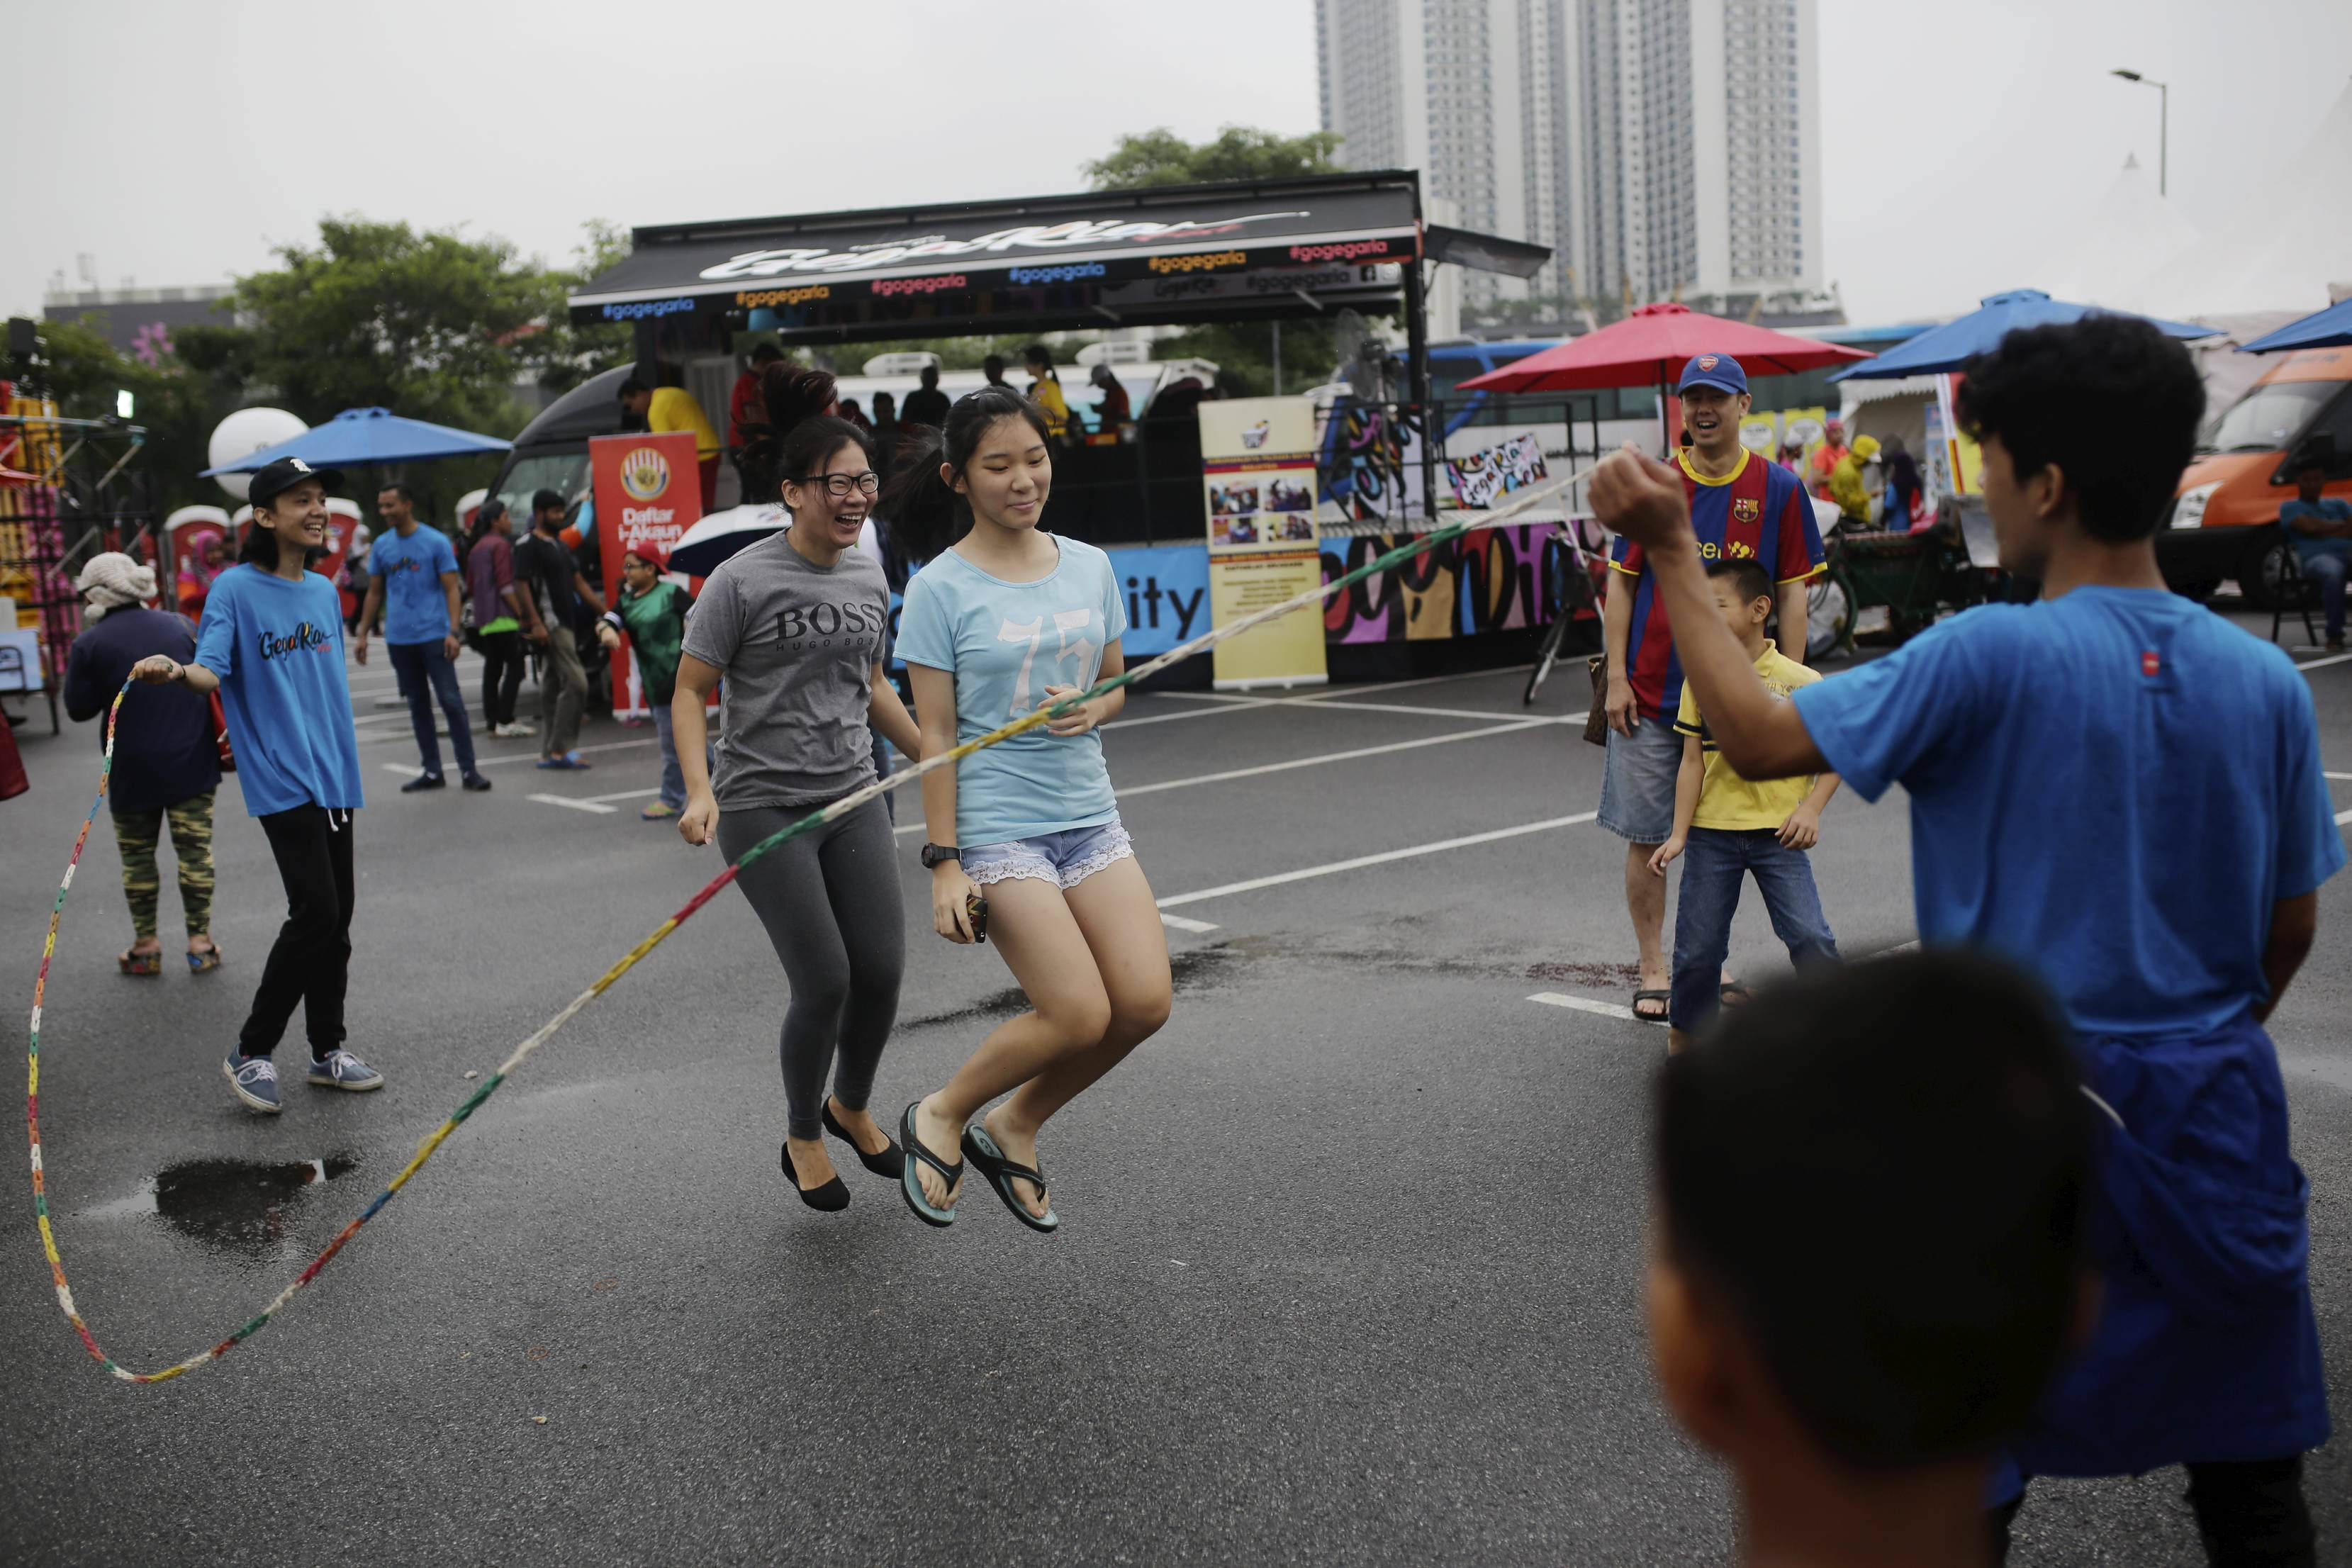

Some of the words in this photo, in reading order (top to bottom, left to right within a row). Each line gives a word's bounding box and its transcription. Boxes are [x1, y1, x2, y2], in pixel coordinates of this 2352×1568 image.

[1149, 250, 1246, 274] #gogegaria
[1289, 239, 1388, 262] #gogegaria
[872, 273, 966, 296] #gogegaria
[1009, 262, 1106, 284] #gogegaria
[735, 285, 829, 308] #gogegaria
[603, 297, 695, 321] #gogegaria
[622, 506, 674, 525] Daftar
[775, 602, 880, 640] BOSS
[777, 639, 831, 651] HUGO
[844, 637, 875, 647] BOS
